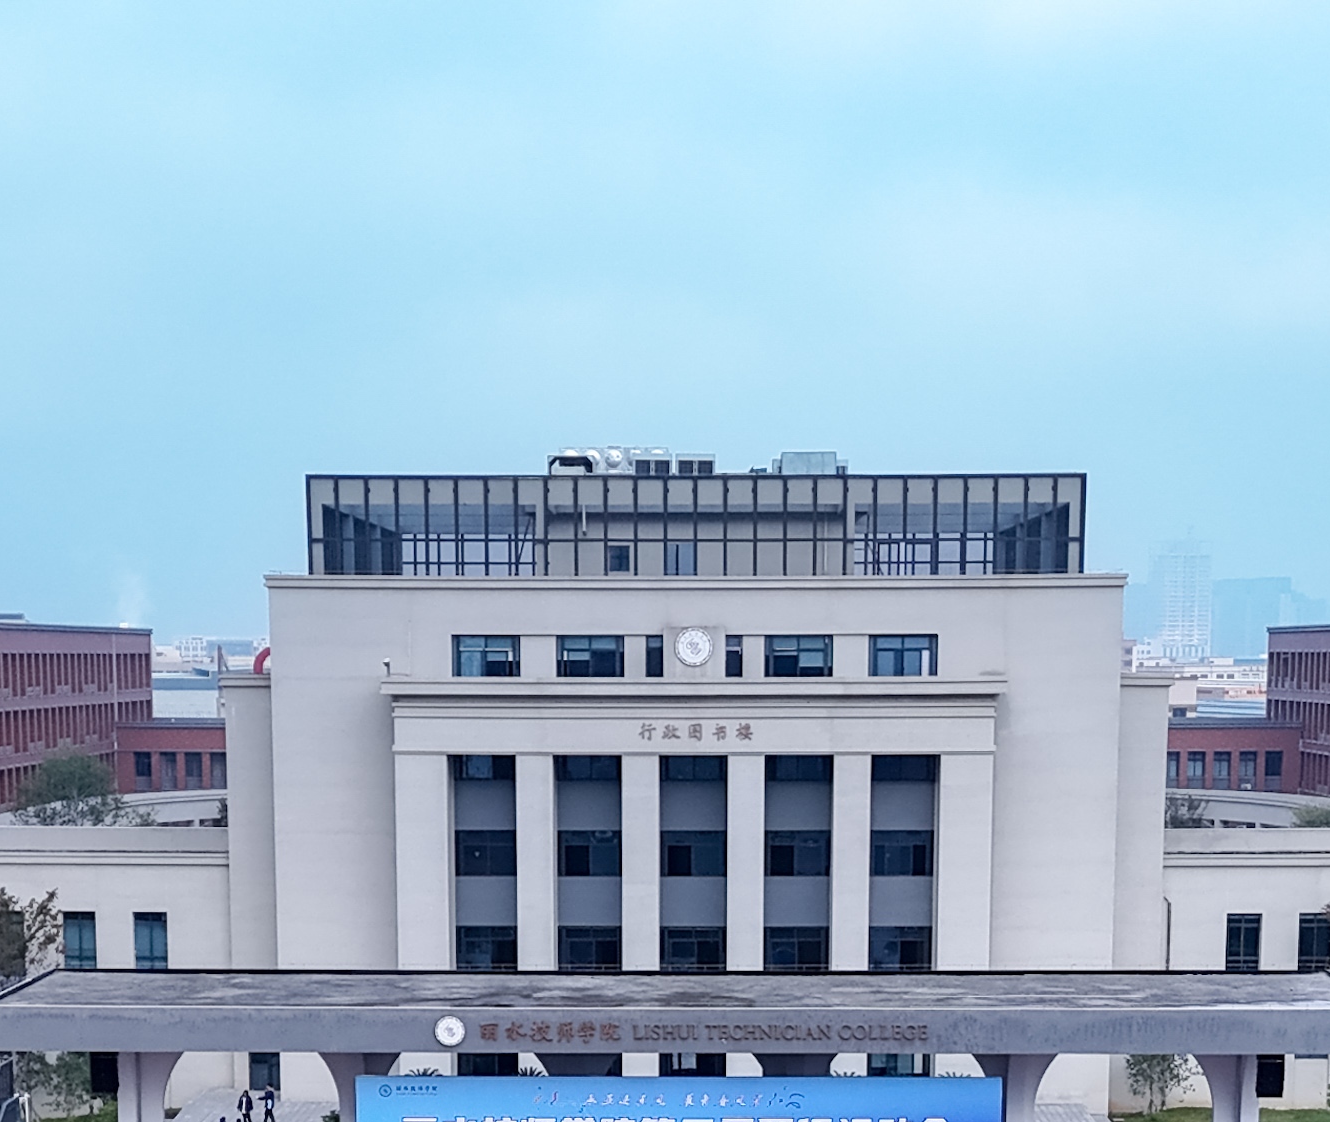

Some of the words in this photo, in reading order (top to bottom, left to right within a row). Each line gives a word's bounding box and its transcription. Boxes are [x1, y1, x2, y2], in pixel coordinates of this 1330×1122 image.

[638, 722, 754, 742] 行政图书楼
[479, 1021, 621, 1044] 丽水技师学院
[632, 1024, 698, 1041] LISHUI
[705, 1024, 831, 1041] TECHNICIAN
[837, 1024, 929, 1041] COLLEGE
